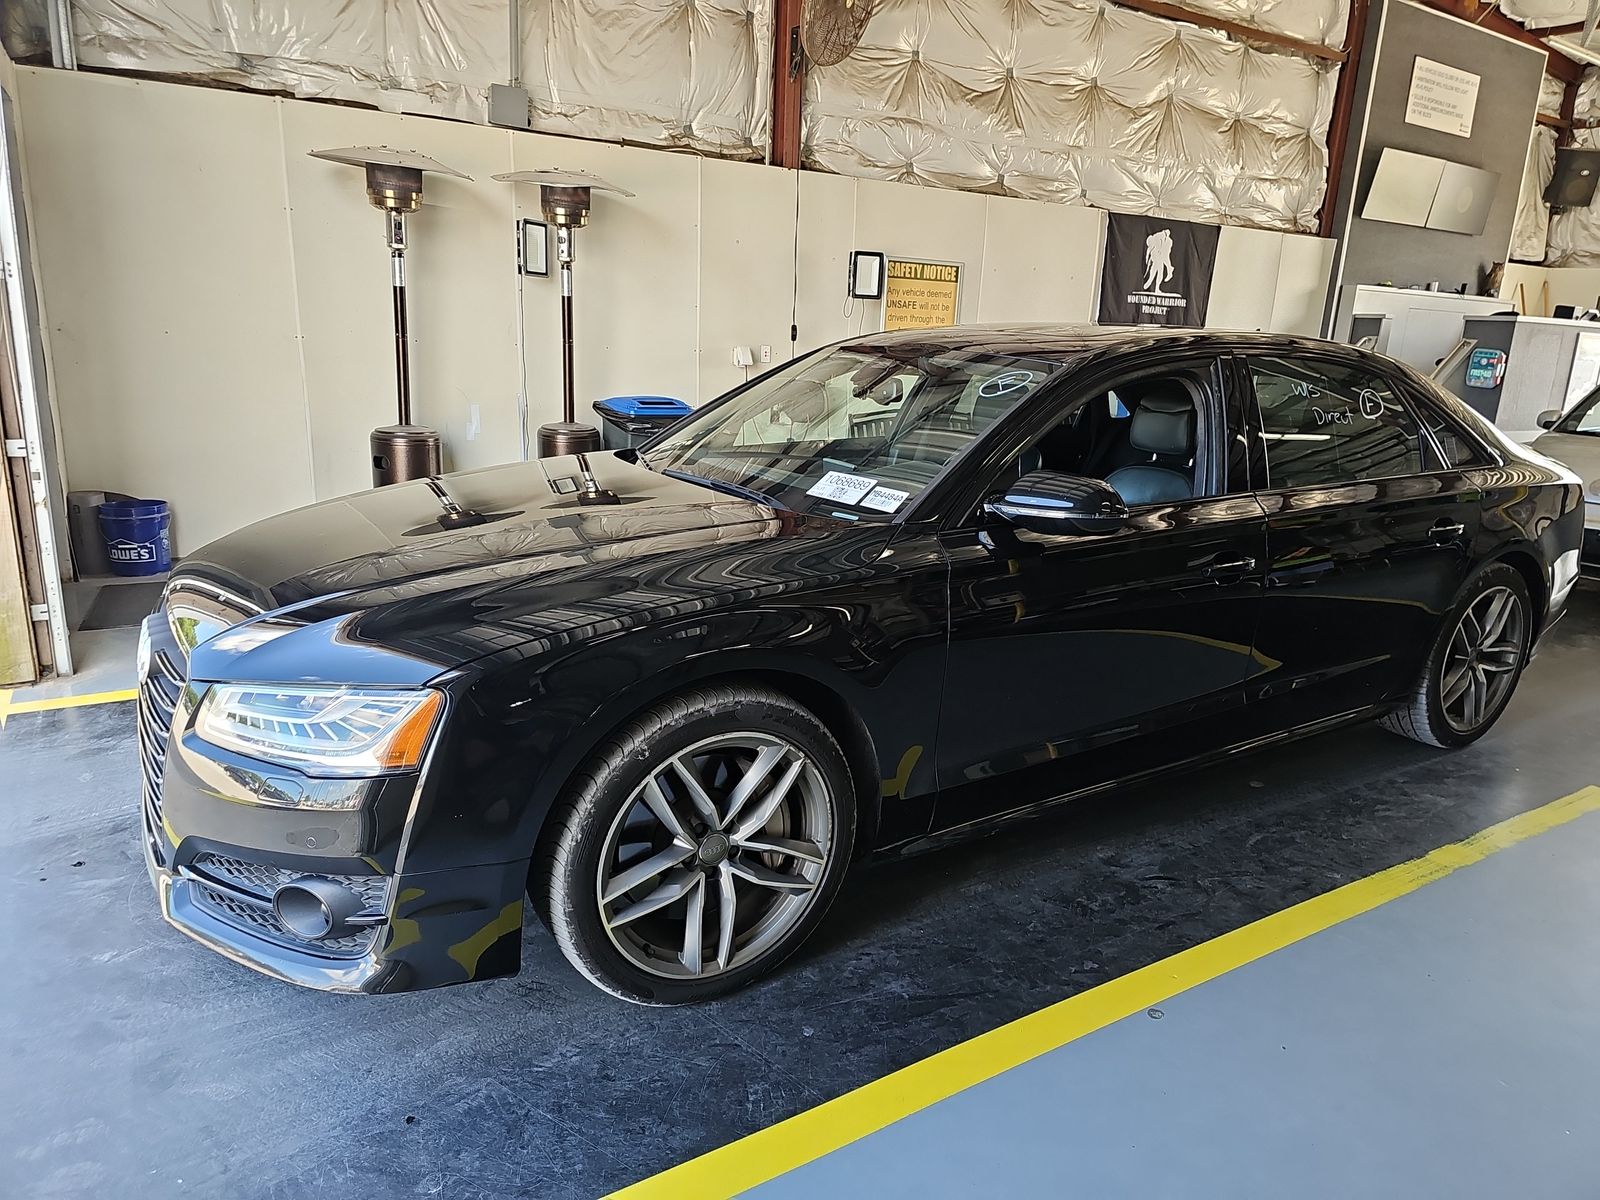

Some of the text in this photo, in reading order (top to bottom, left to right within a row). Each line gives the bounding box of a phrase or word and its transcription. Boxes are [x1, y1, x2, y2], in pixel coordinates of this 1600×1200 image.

[888, 262, 957, 281] SAFETY NOTICE
[888, 286, 952, 298] Any vehicle deemed
[887, 300, 950, 312] UNSAFE will not be
[1127, 294, 1186, 308] WOUNDED WARRIOR
[1142, 305, 1167, 315] PROJECT
[888, 312, 946, 325] driven through the
[1312, 406, 1354, 424] Direct
[824, 474, 872, 490] 1068689
